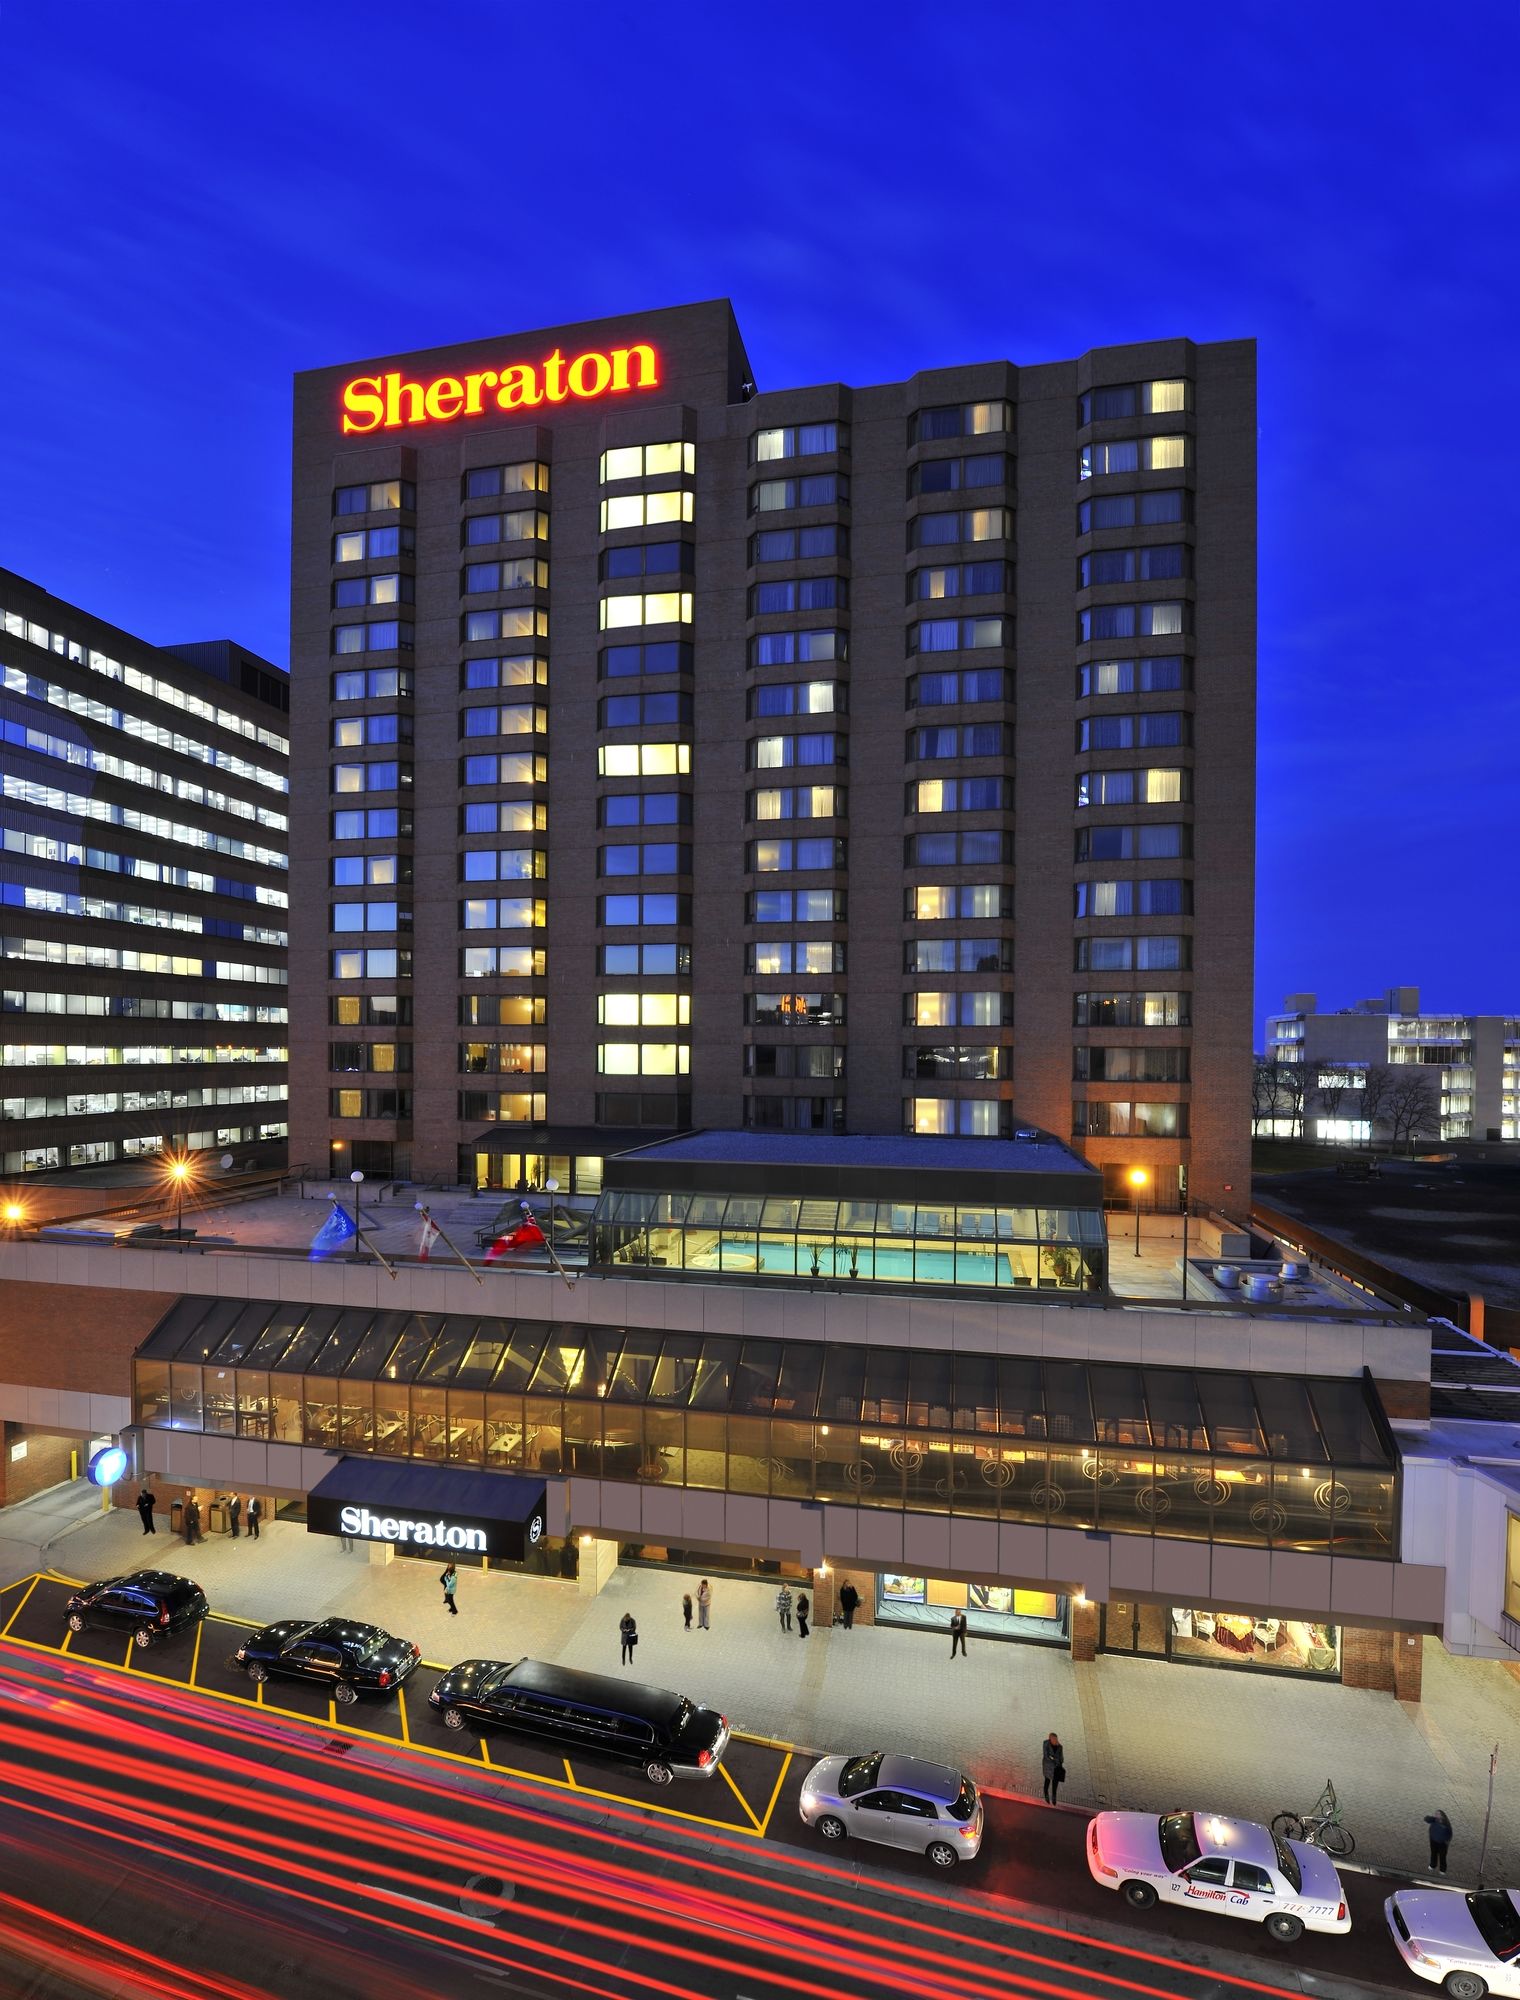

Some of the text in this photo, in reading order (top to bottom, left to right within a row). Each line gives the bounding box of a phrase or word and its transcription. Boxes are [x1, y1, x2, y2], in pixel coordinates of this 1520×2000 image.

[343, 344, 658, 433] Sheraton
[340, 1506, 488, 1551] Sheraton
[1187, 1885, 1249, 1906] Hamilton Cab
